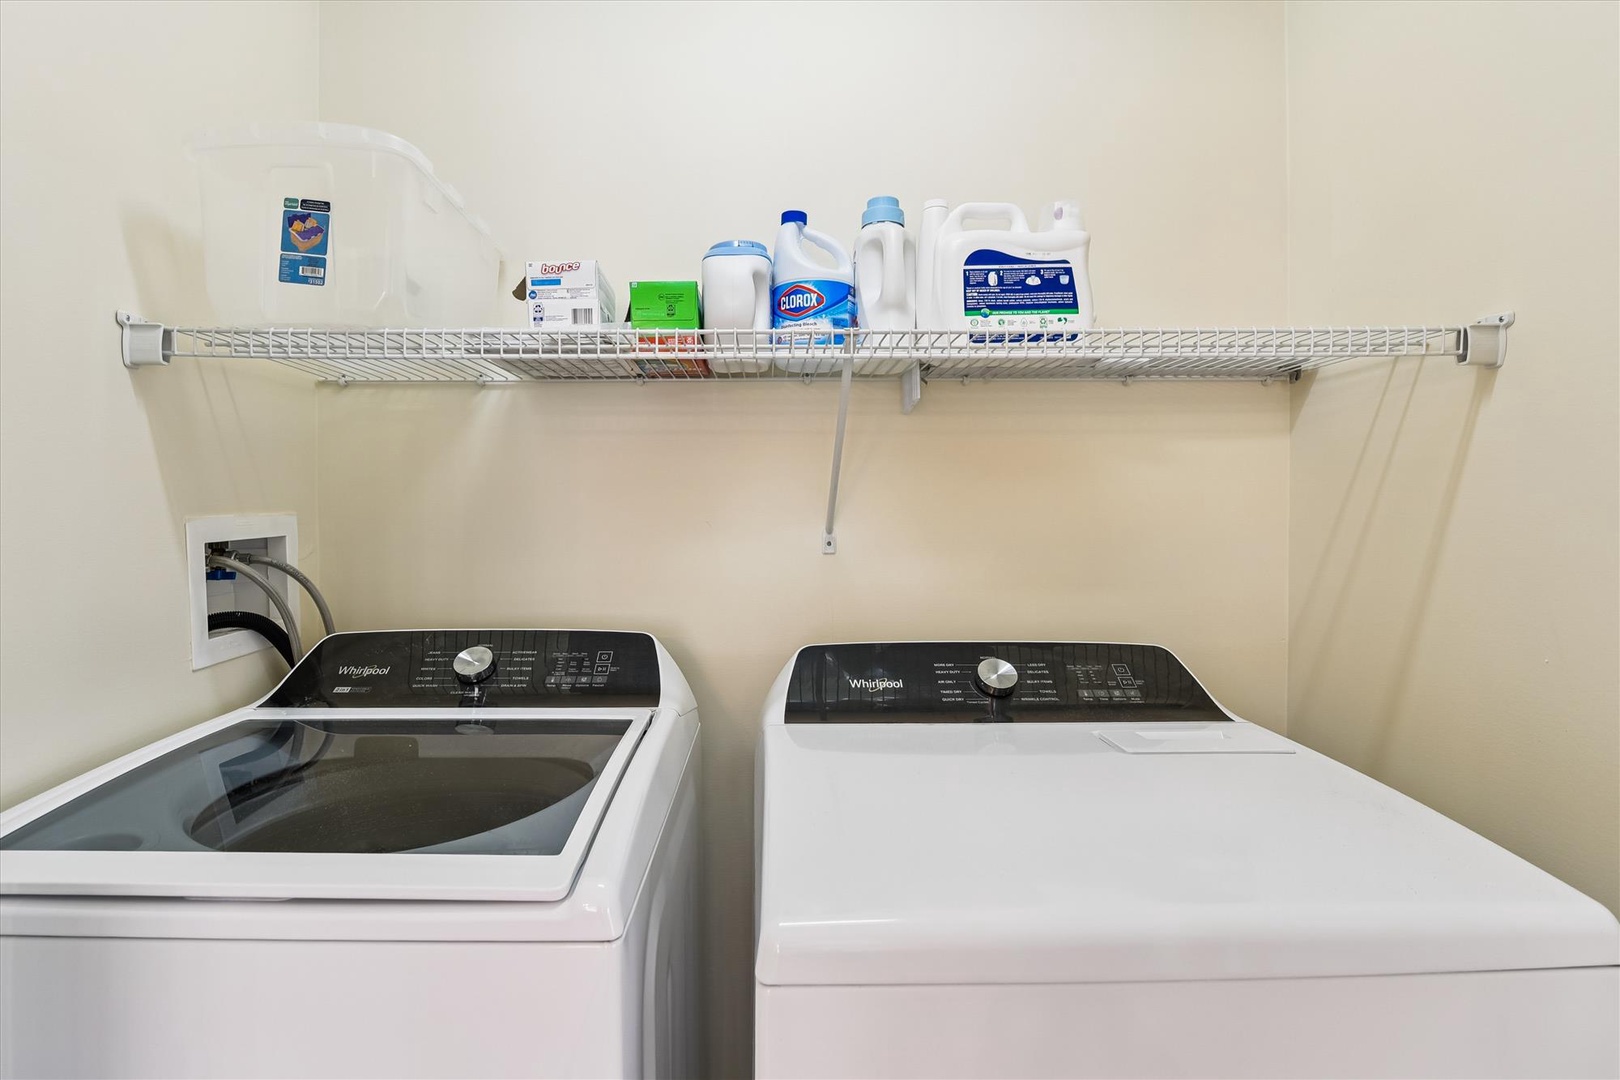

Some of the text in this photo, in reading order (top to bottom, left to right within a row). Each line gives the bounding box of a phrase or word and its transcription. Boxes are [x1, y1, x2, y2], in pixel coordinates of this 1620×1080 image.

[541, 261, 580, 275] bounce
[780, 293, 818, 311] CLOROX
[338, 665, 391, 678] Whirlpool
[849, 678, 903, 691] Whirlpool
